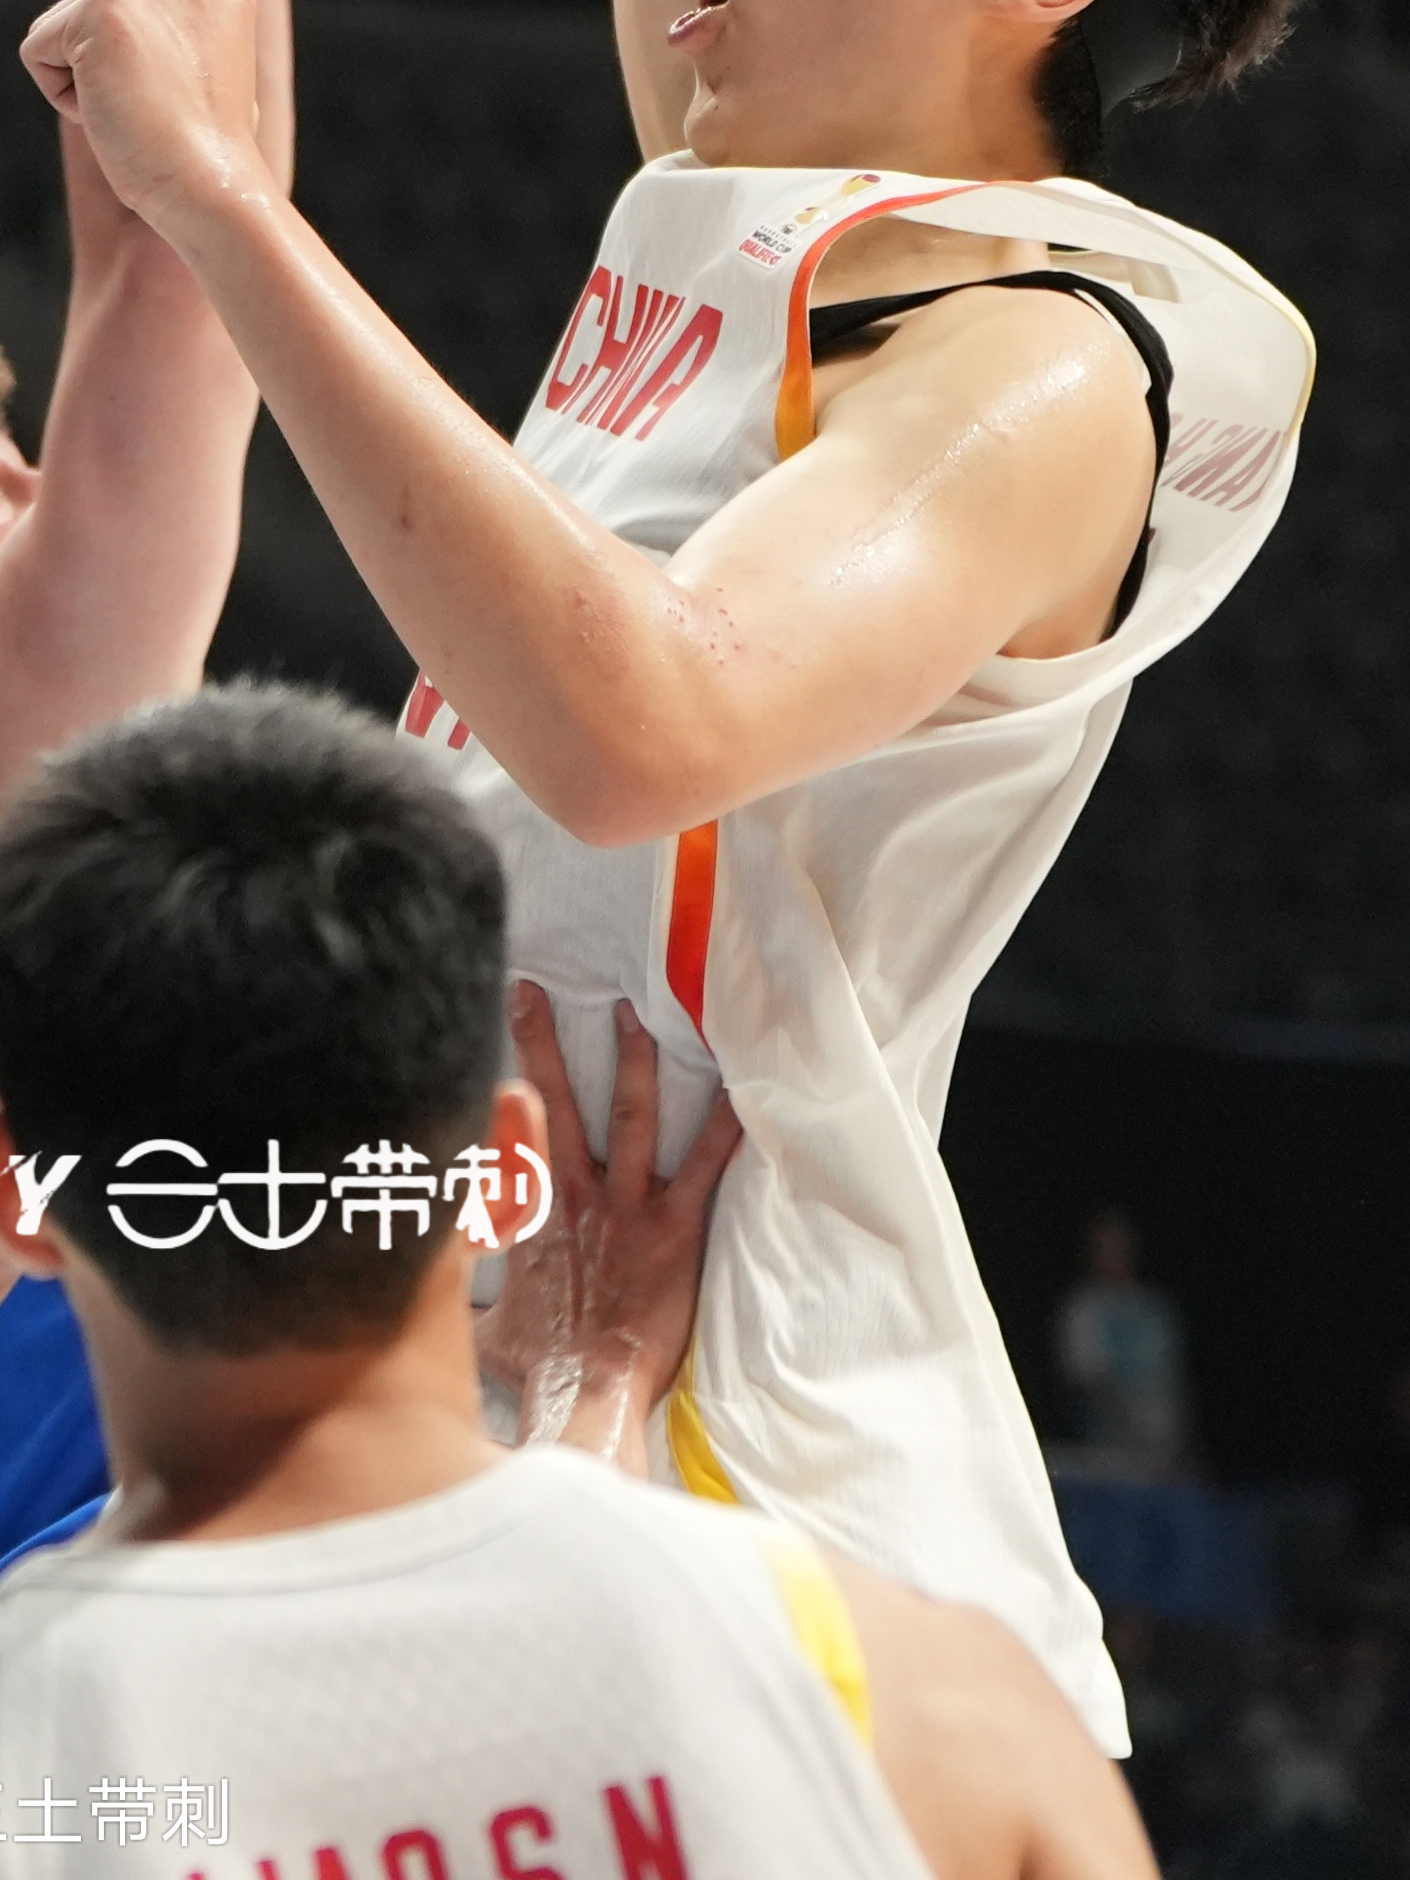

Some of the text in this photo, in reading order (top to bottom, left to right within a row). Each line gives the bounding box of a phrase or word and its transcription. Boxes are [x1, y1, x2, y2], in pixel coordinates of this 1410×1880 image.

[752, 230, 793, 254] WORLD CUP
[545, 264, 724, 441] CHINA
